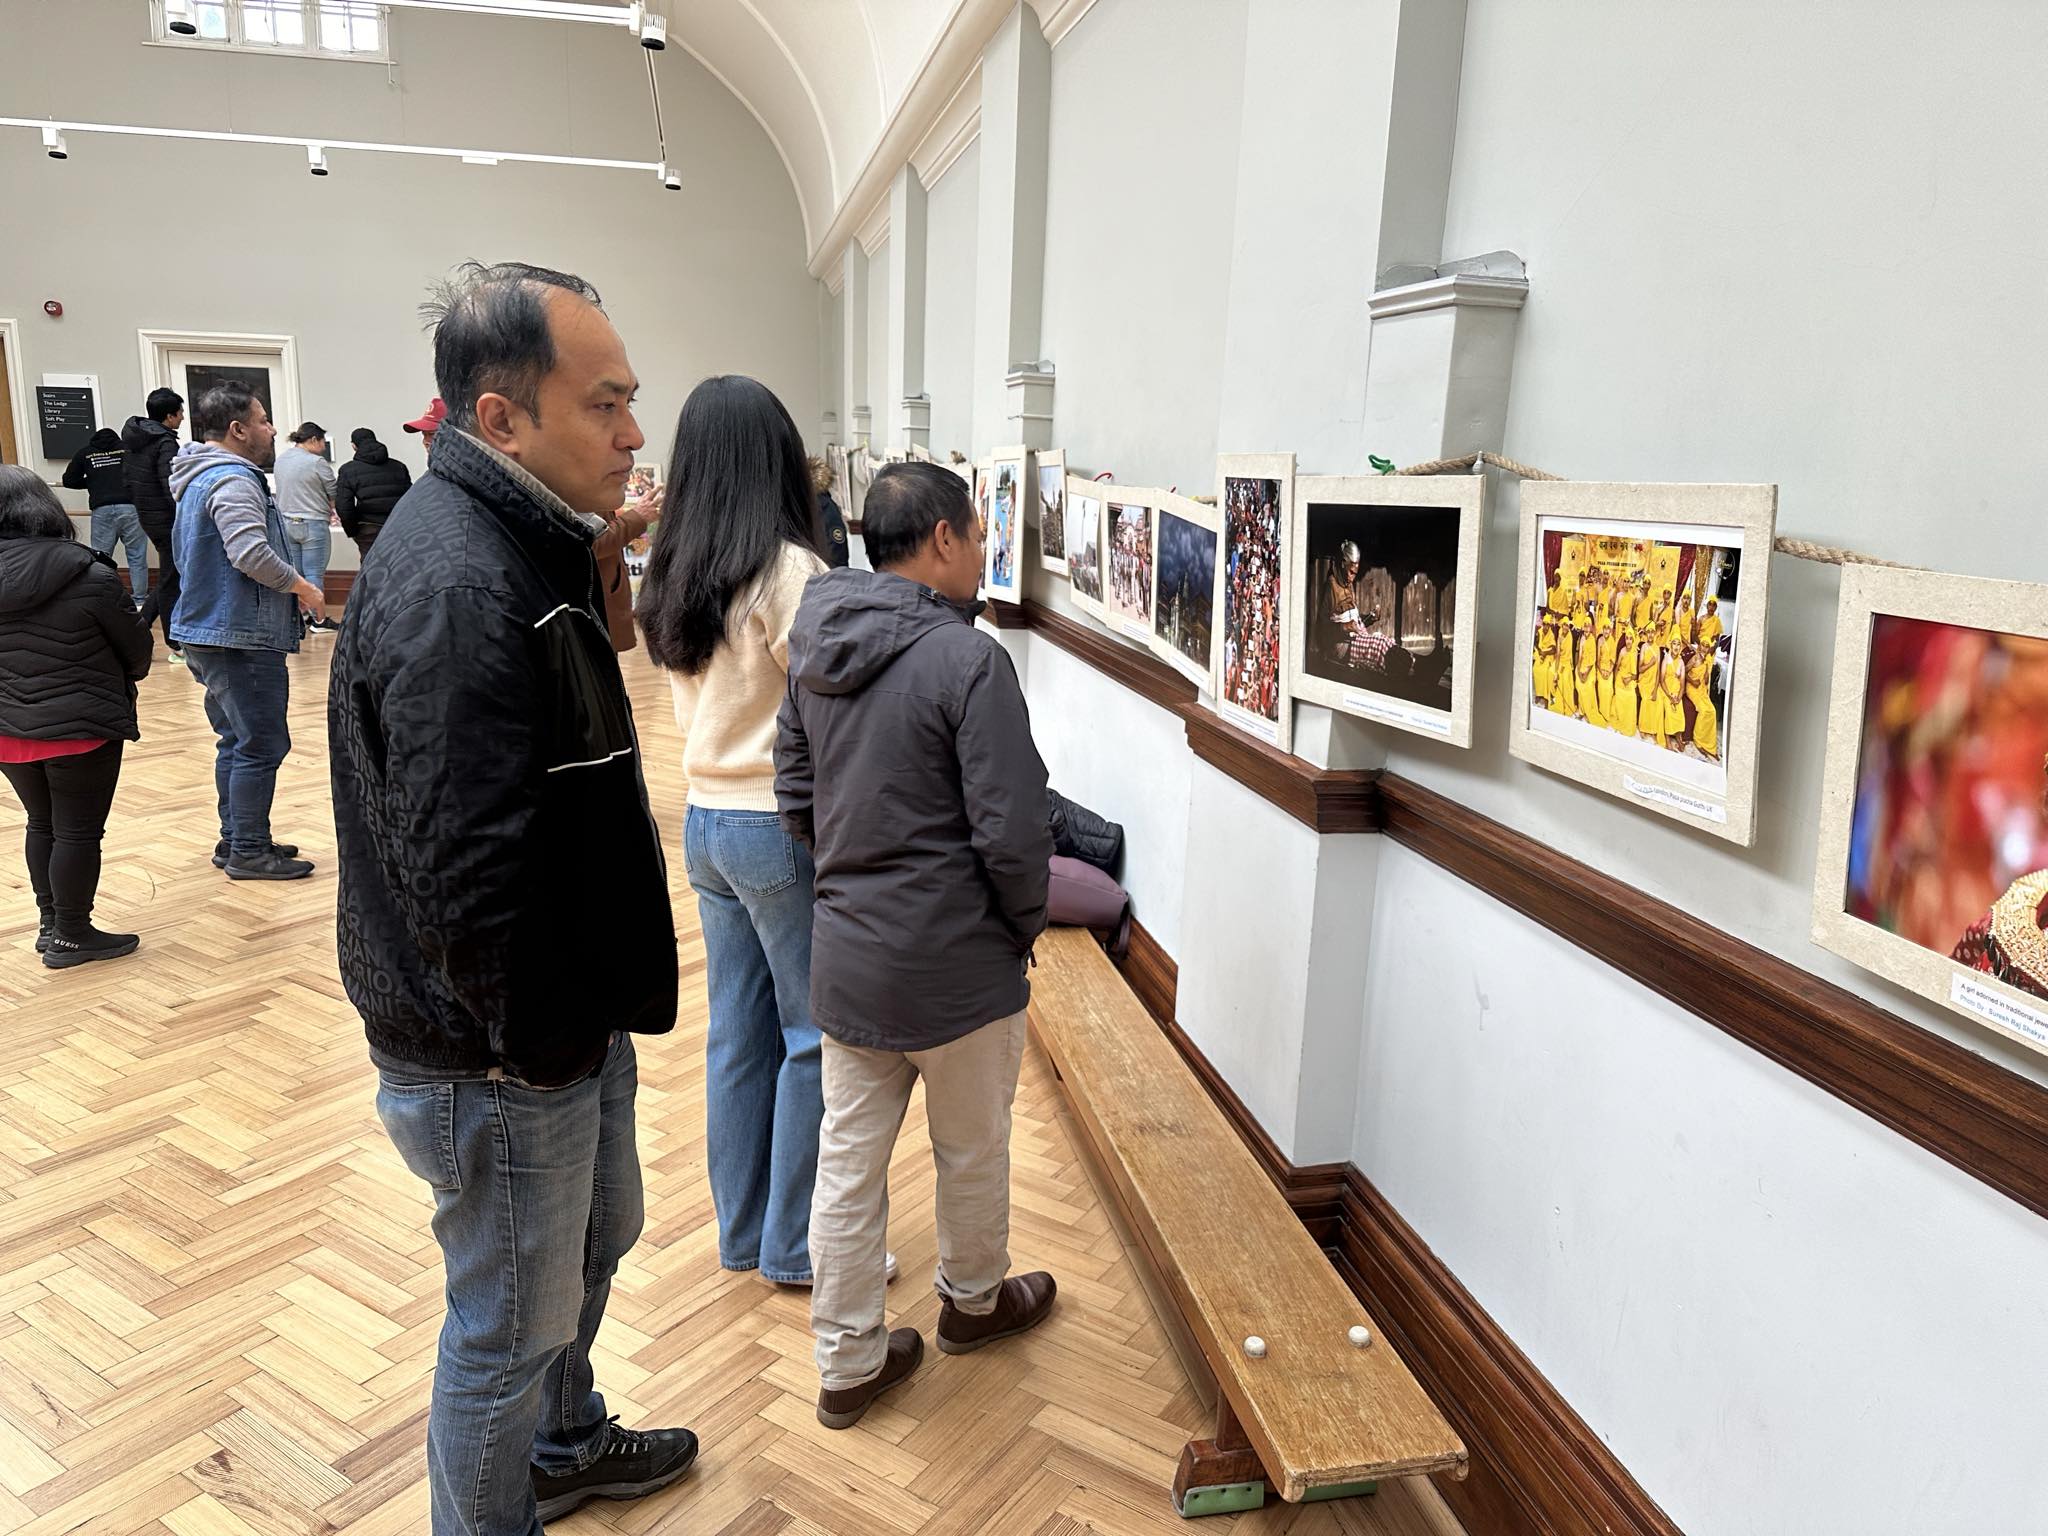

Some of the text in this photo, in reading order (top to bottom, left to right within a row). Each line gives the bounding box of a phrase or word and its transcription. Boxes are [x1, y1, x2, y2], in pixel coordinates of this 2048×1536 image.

[53, 939, 80, 949] GUESS
[1976, 991, 1999, 1006] adorned
[2005, 1004, 2034, 1022] traditional
[1988, 1008, 2010, 1023] Suresh
[2010, 1018, 2022, 1030] Raj
[2022, 1024, 2046, 1040] Shakya
